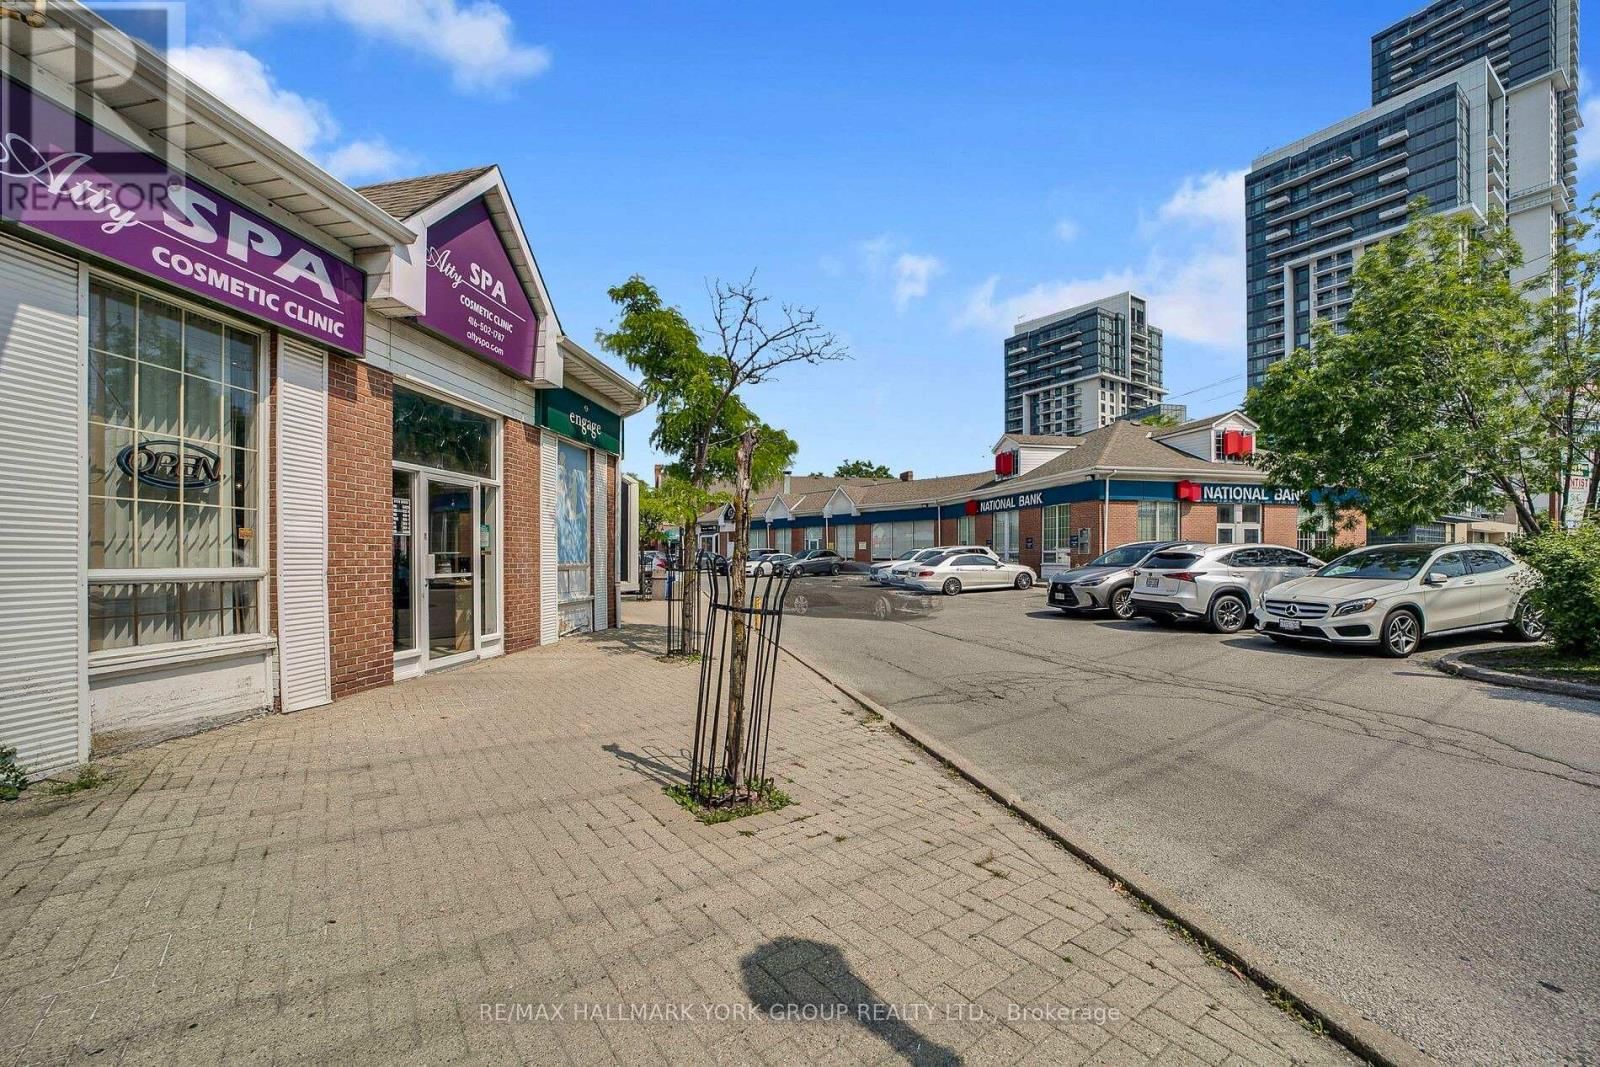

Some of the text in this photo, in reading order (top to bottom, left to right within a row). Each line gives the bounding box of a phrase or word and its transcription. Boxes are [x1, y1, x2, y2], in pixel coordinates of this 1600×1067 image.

[162, 184, 340, 305] SPA
[152, 246, 345, 338] COSMETIC CLINIC
[469, 262, 507, 305] SPA
[460, 294, 513, 334] COSMETIC CLINIC
[466, 331, 504, 356] attyspa.com
[467, 316, 505, 343] 416-502-1787
[569, 411, 602, 439] engage
[128, 448, 224, 481] OPEN
[980, 492, 1043, 513] NATIONAL BANK
[1203, 486, 1270, 500] NATIONAL
